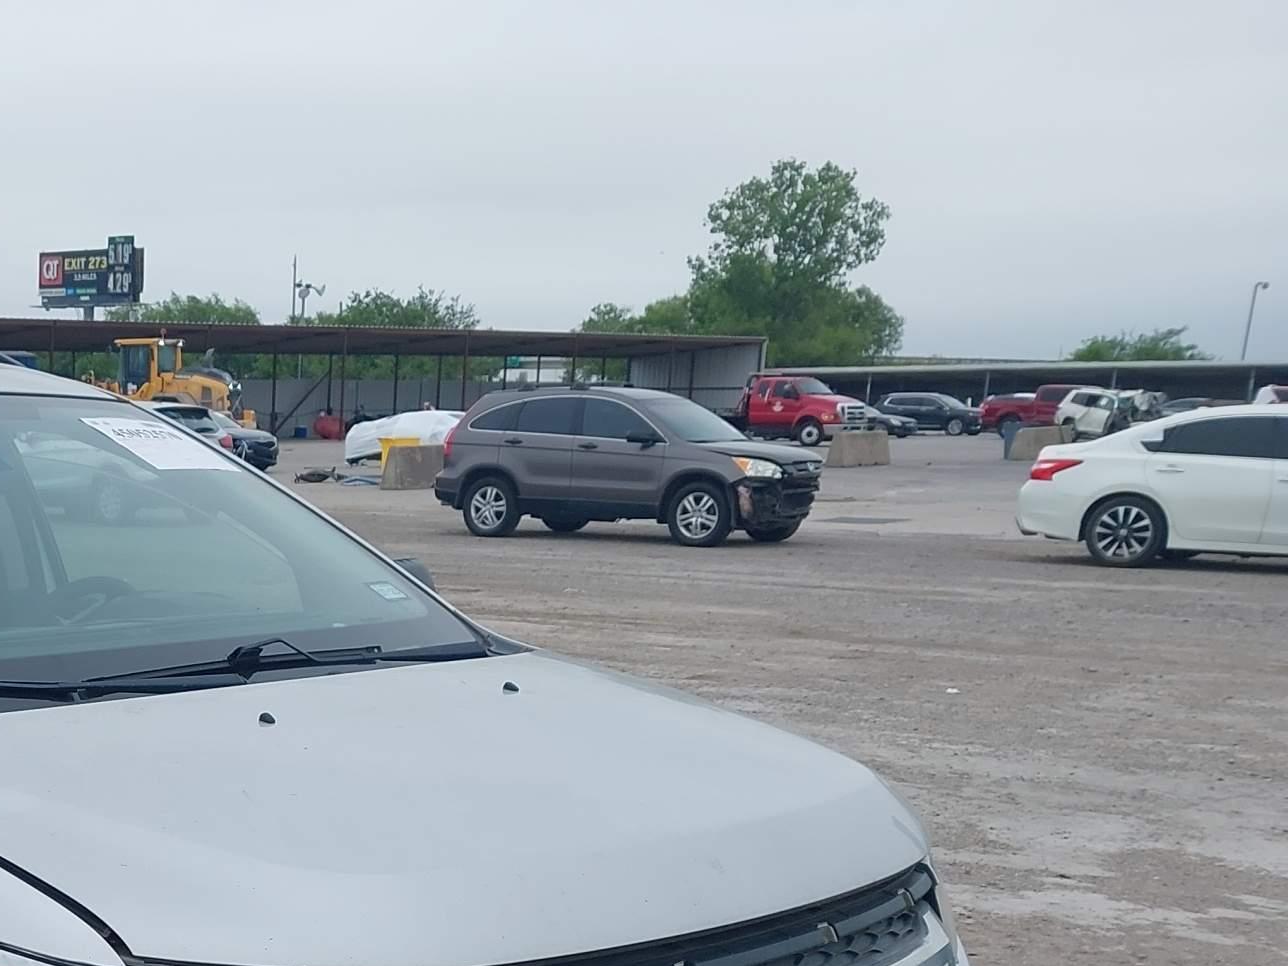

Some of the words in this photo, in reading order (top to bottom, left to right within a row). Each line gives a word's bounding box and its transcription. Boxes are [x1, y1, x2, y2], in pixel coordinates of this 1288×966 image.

[43, 259, 59, 280] QT
[64, 256, 87, 270] EXIT
[88, 255, 108, 270] 273
